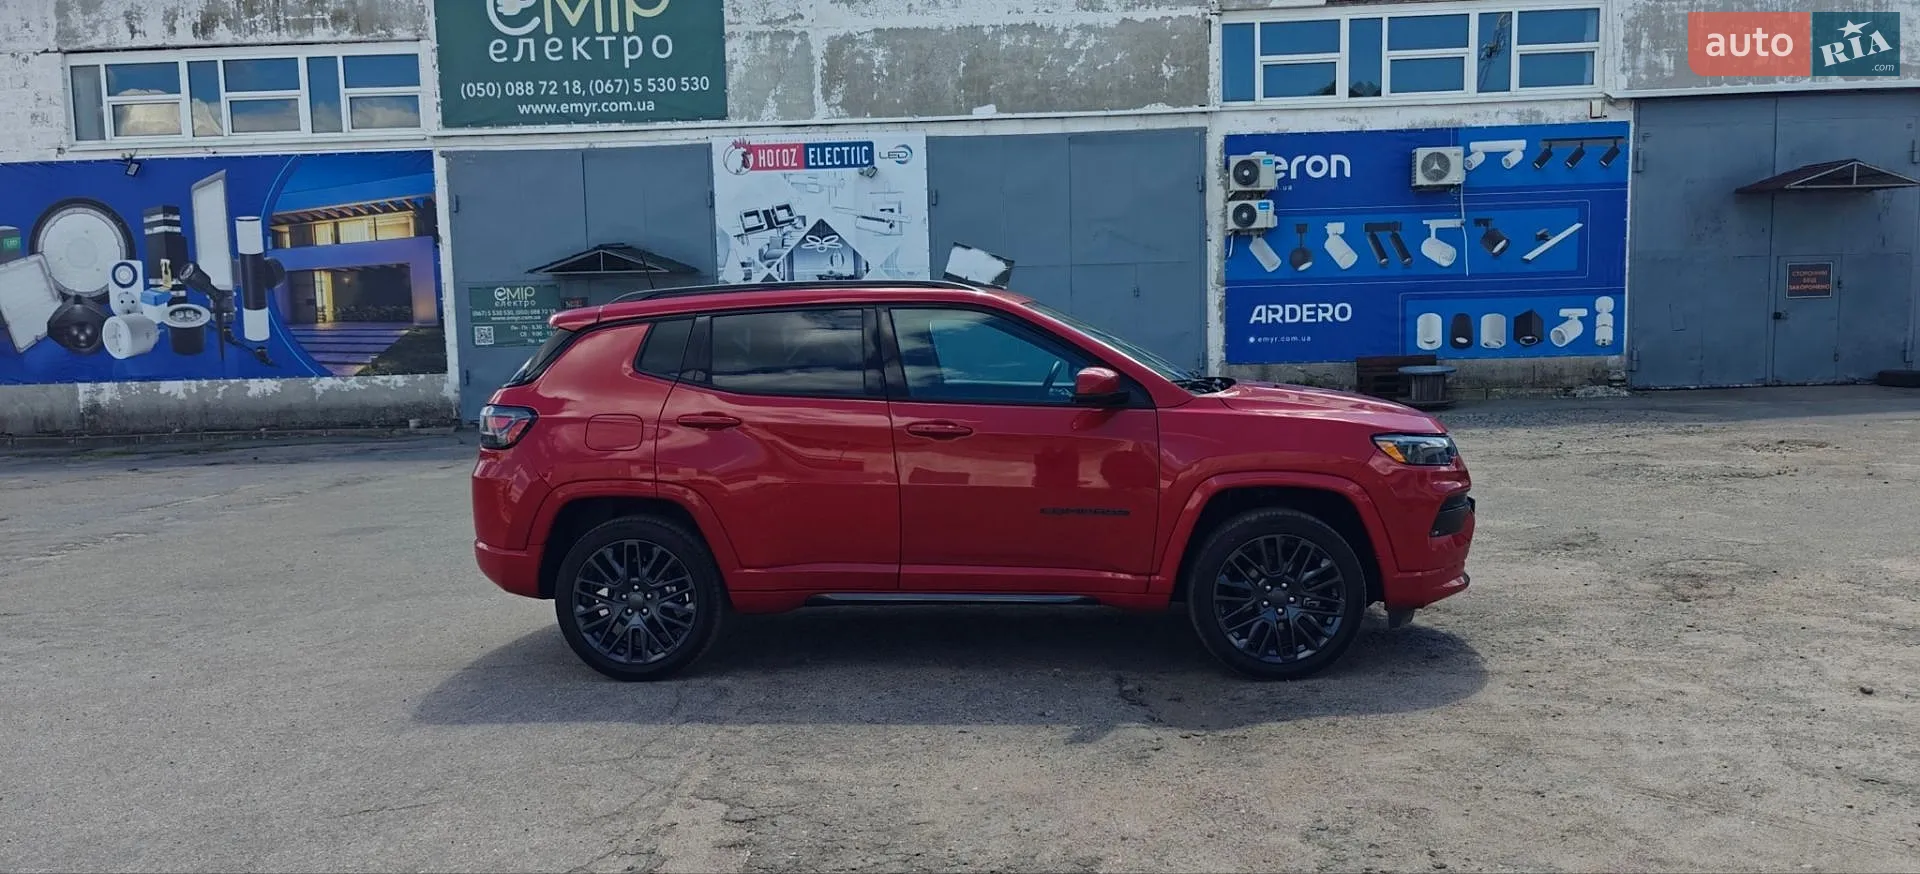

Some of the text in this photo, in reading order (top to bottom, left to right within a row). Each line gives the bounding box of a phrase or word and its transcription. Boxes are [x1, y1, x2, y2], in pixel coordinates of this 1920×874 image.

[488, 34, 673, 68] електро
[460, 76, 710, 99] (050) 088 72 18, (067) 5 530 530
[517, 100, 656, 117] www.emyr.com.ua
[878, 150, 908, 160] LED
[1249, 302, 1353, 325] ARDERO
[1257, 335, 1312, 344] emyr.com.ua
